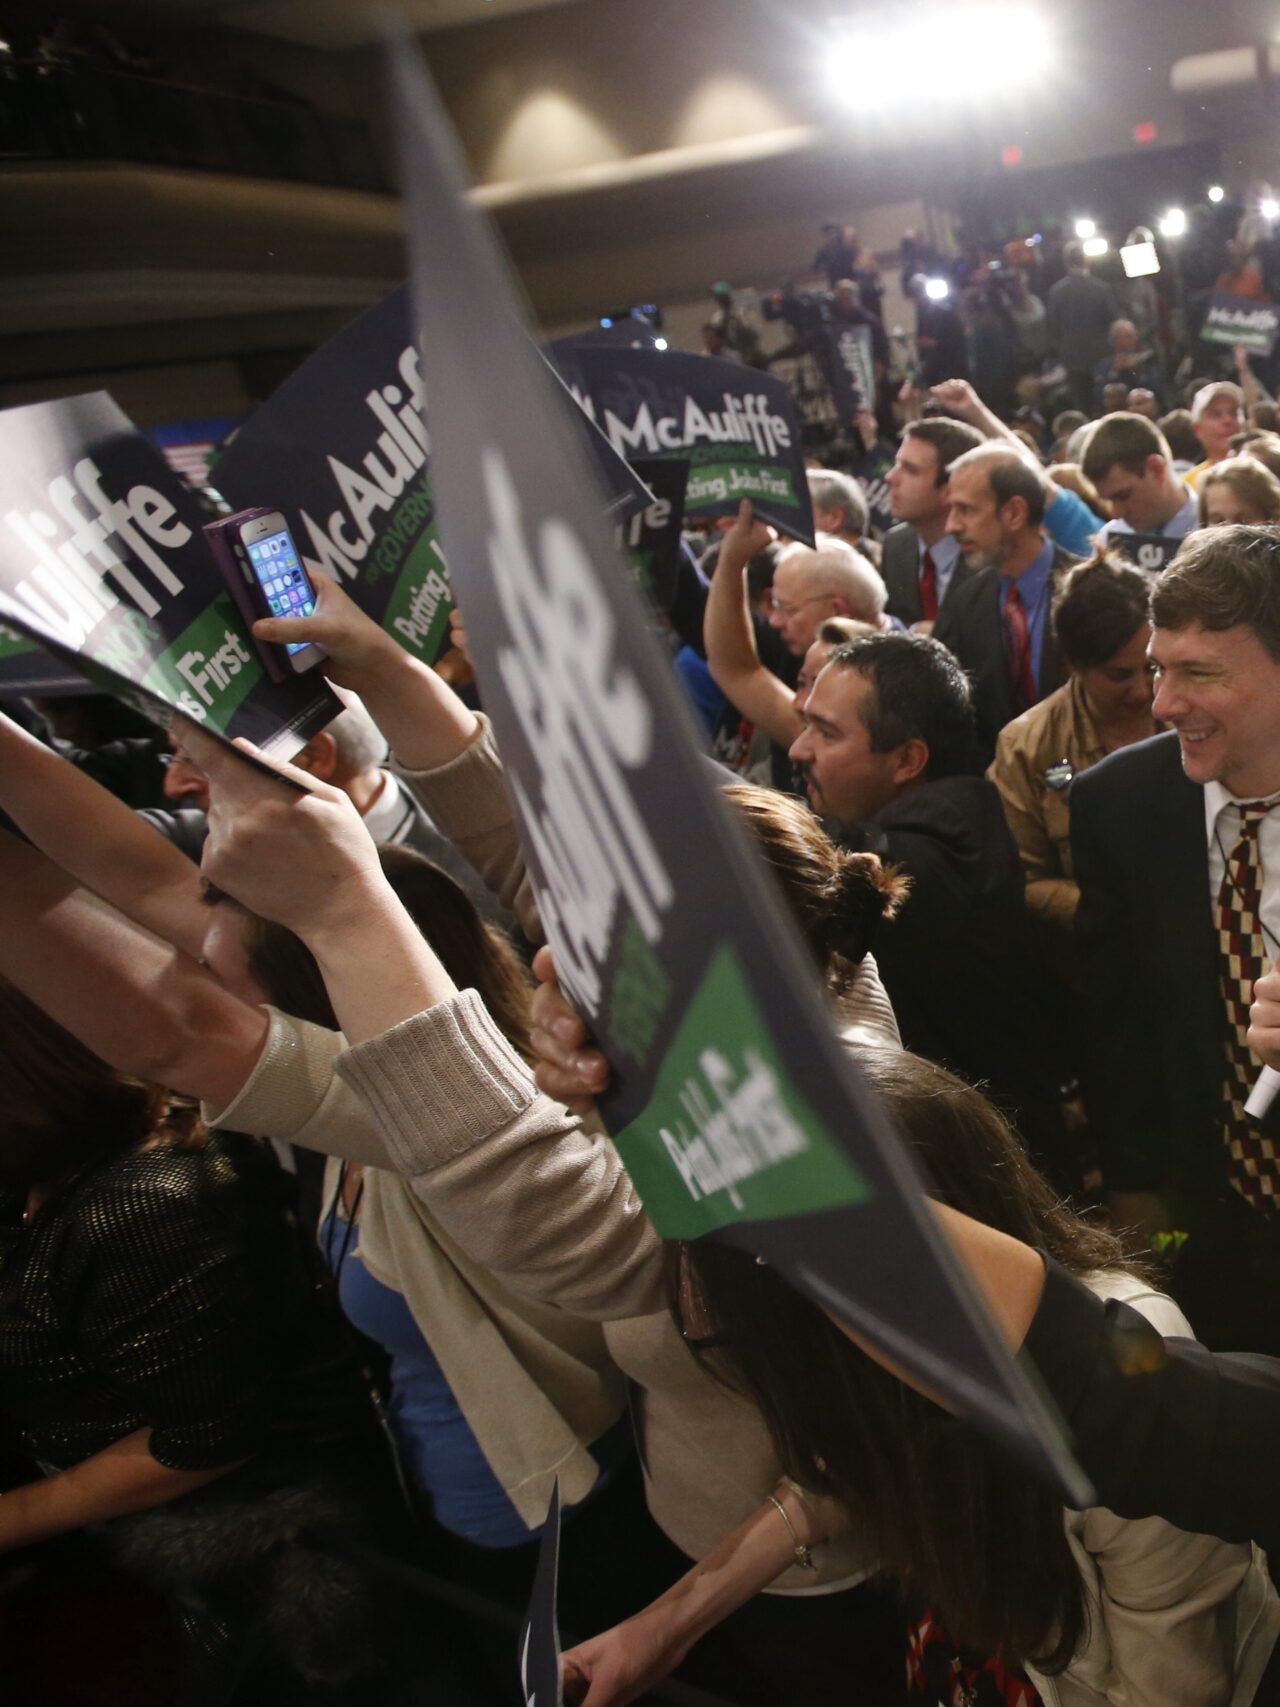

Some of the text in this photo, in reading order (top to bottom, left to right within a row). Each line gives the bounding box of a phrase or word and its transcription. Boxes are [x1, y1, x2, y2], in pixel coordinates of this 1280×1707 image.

[604, 392, 792, 459] McAuliffe
[0, 456, 193, 651] uliffe
[376, 477, 434, 575] GOVERN
[392, 567, 452, 650] Putting
[174, 629, 251, 707] First
